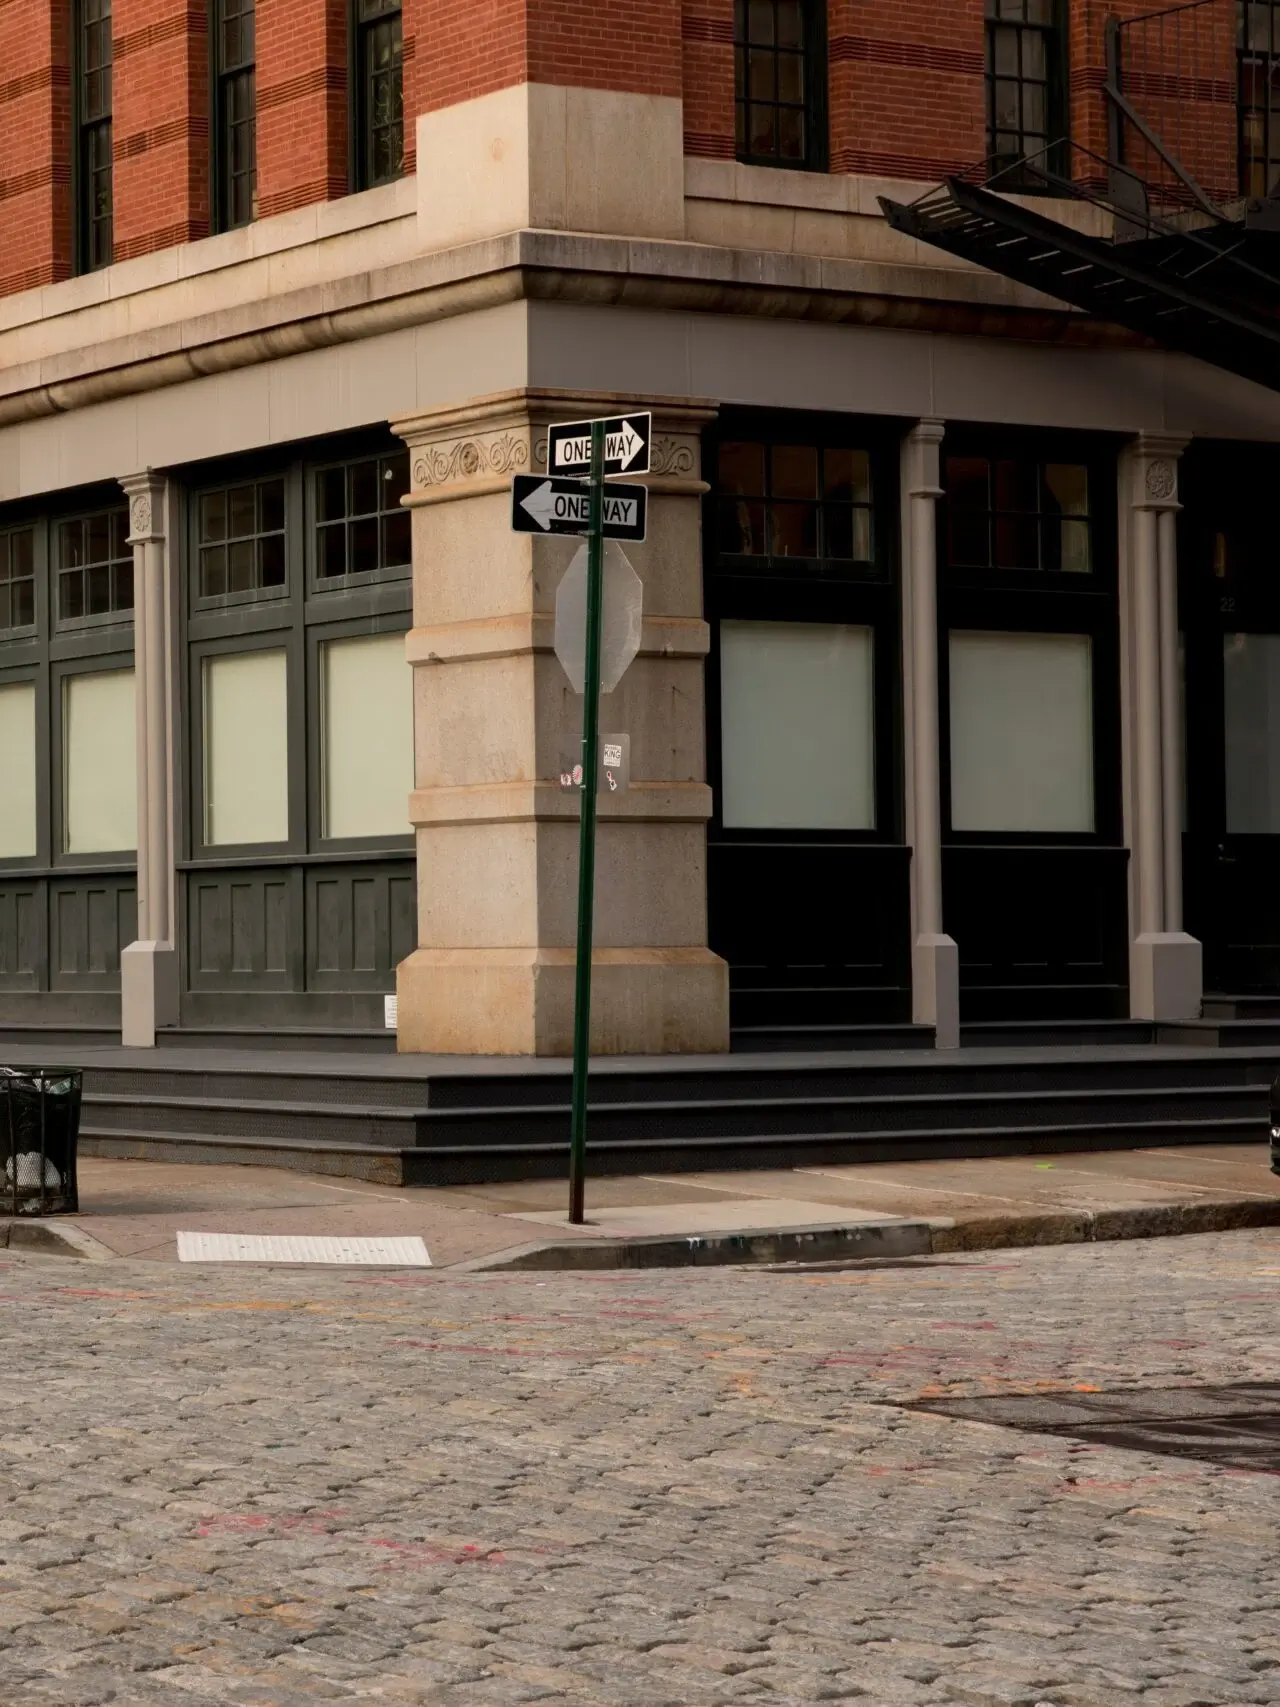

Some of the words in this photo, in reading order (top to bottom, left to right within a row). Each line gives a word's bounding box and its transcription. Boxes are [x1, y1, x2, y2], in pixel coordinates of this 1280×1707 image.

[564, 439, 591, 462] ONE
[607, 434, 635, 457] WAY
[555, 496, 589, 519] ONE
[1220, 597, 1236, 612] 22
[605, 750, 621, 759] KING
